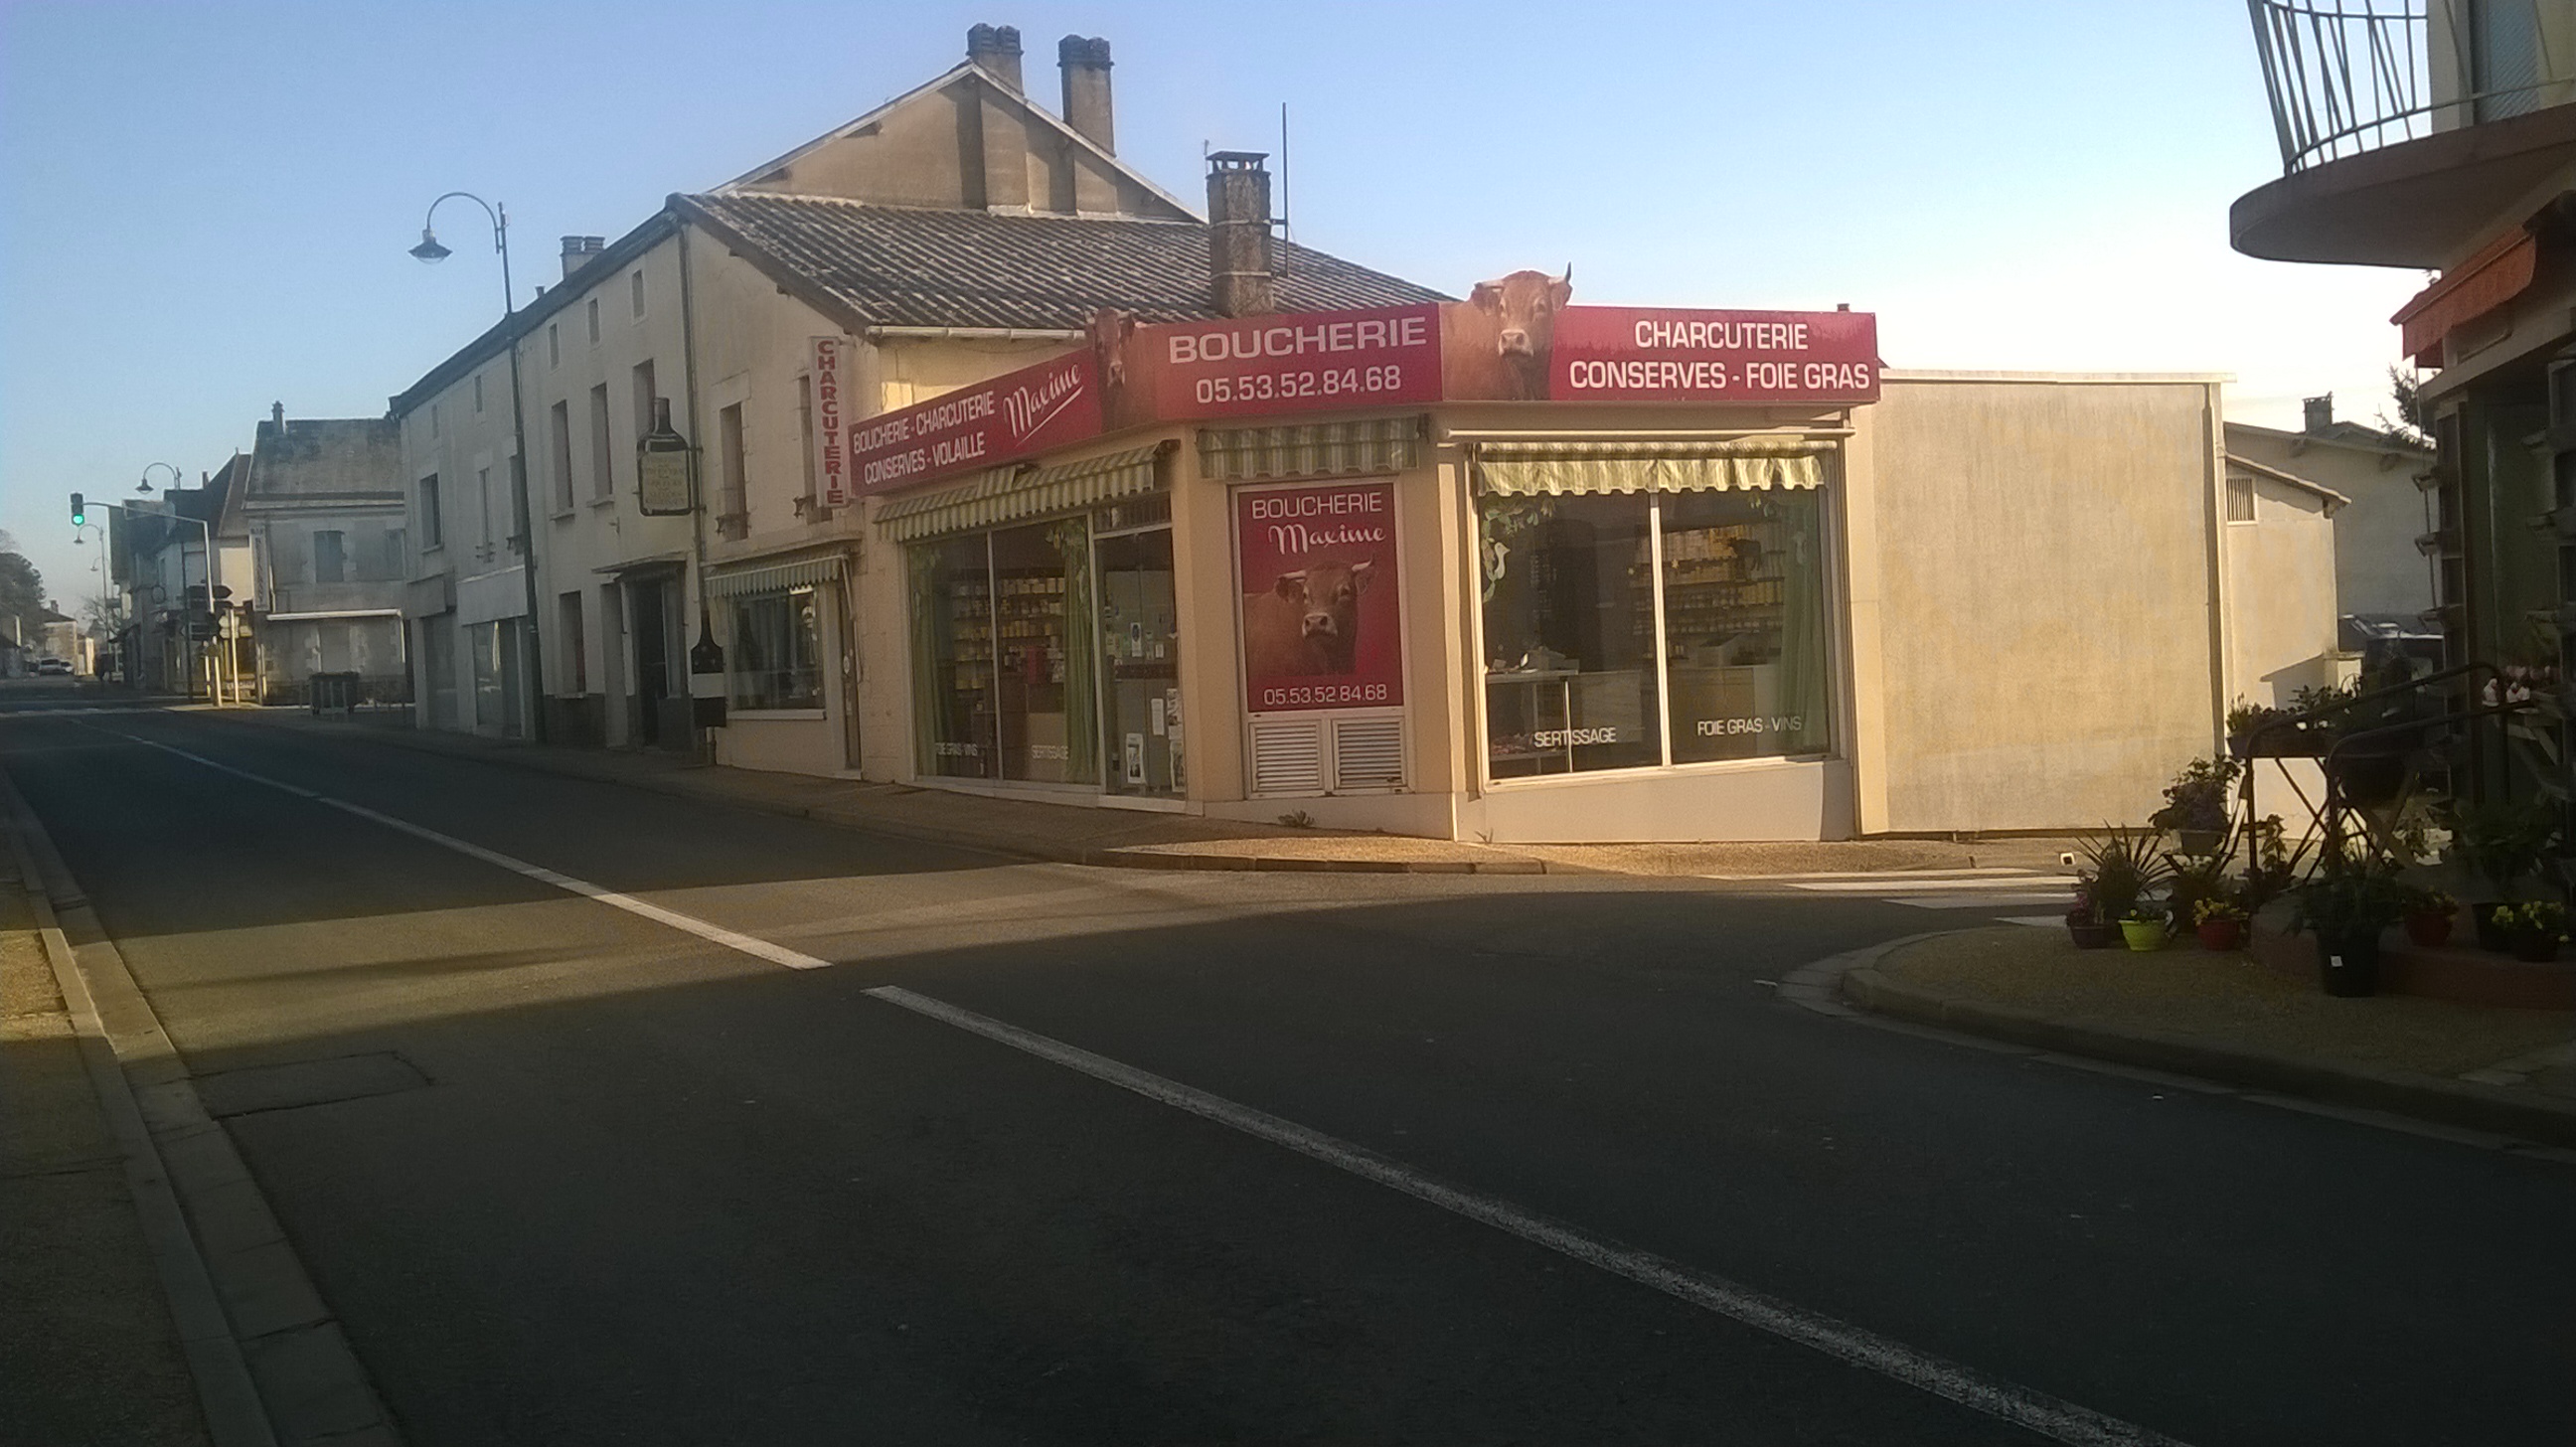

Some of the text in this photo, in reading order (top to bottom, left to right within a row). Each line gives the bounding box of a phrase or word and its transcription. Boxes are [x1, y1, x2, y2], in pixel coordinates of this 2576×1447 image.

[1169, 316, 1427, 365] BOUCHERIE
[1635, 320, 1809, 350] CHARCUTERIE
[1196, 365, 1402, 404] 05.53.52.84.68
[1569, 360, 1727, 390] CONSERVES
[1746, 362, 1798, 390] FOIE
[1804, 362, 1870, 390] GRAS
[1002, 363, 1082, 438] Maxime
[817, 340, 844, 505] CHARCUTERIE
[853, 416, 910, 455] BOUCHERIE
[915, 390, 996, 437] CHARCUTERIE
[864, 448, 926, 485] CONSERVES
[931, 430, 986, 467] VOLAILLE
[1251, 491, 1382, 520] BOUCHERIE
[1267, 523, 1387, 556] Maxime
[1533, 726, 1617, 748] SERTISSAGE
[1696, 720, 1725, 737] FOIE
[1726, 717, 1764, 734] GRAS
[1771, 716, 1802, 732] VINS
